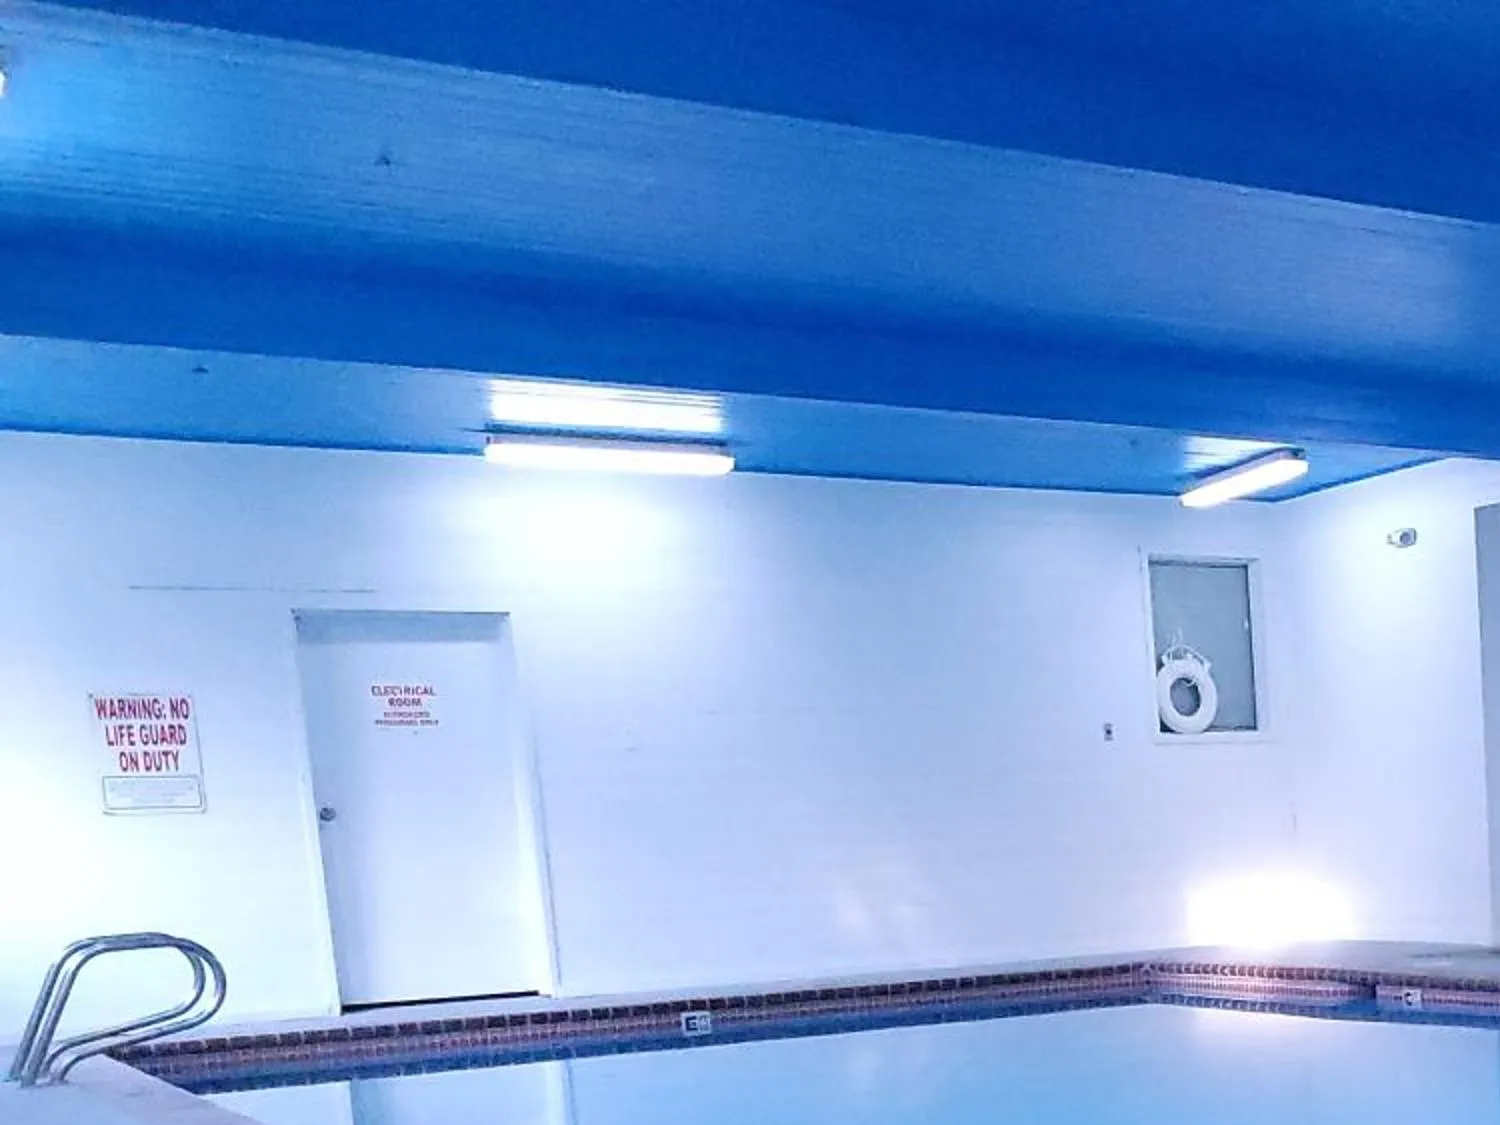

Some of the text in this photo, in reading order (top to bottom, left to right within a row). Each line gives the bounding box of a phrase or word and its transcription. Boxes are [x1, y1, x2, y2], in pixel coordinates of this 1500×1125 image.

[371, 685, 436, 697] ELECTRICAL
[388, 697, 423, 707] ROOM
[95, 697, 190, 720] WARNING: NO
[105, 723, 187, 746] LIFE GUARD
[119, 750, 179, 772] ON DUTY
